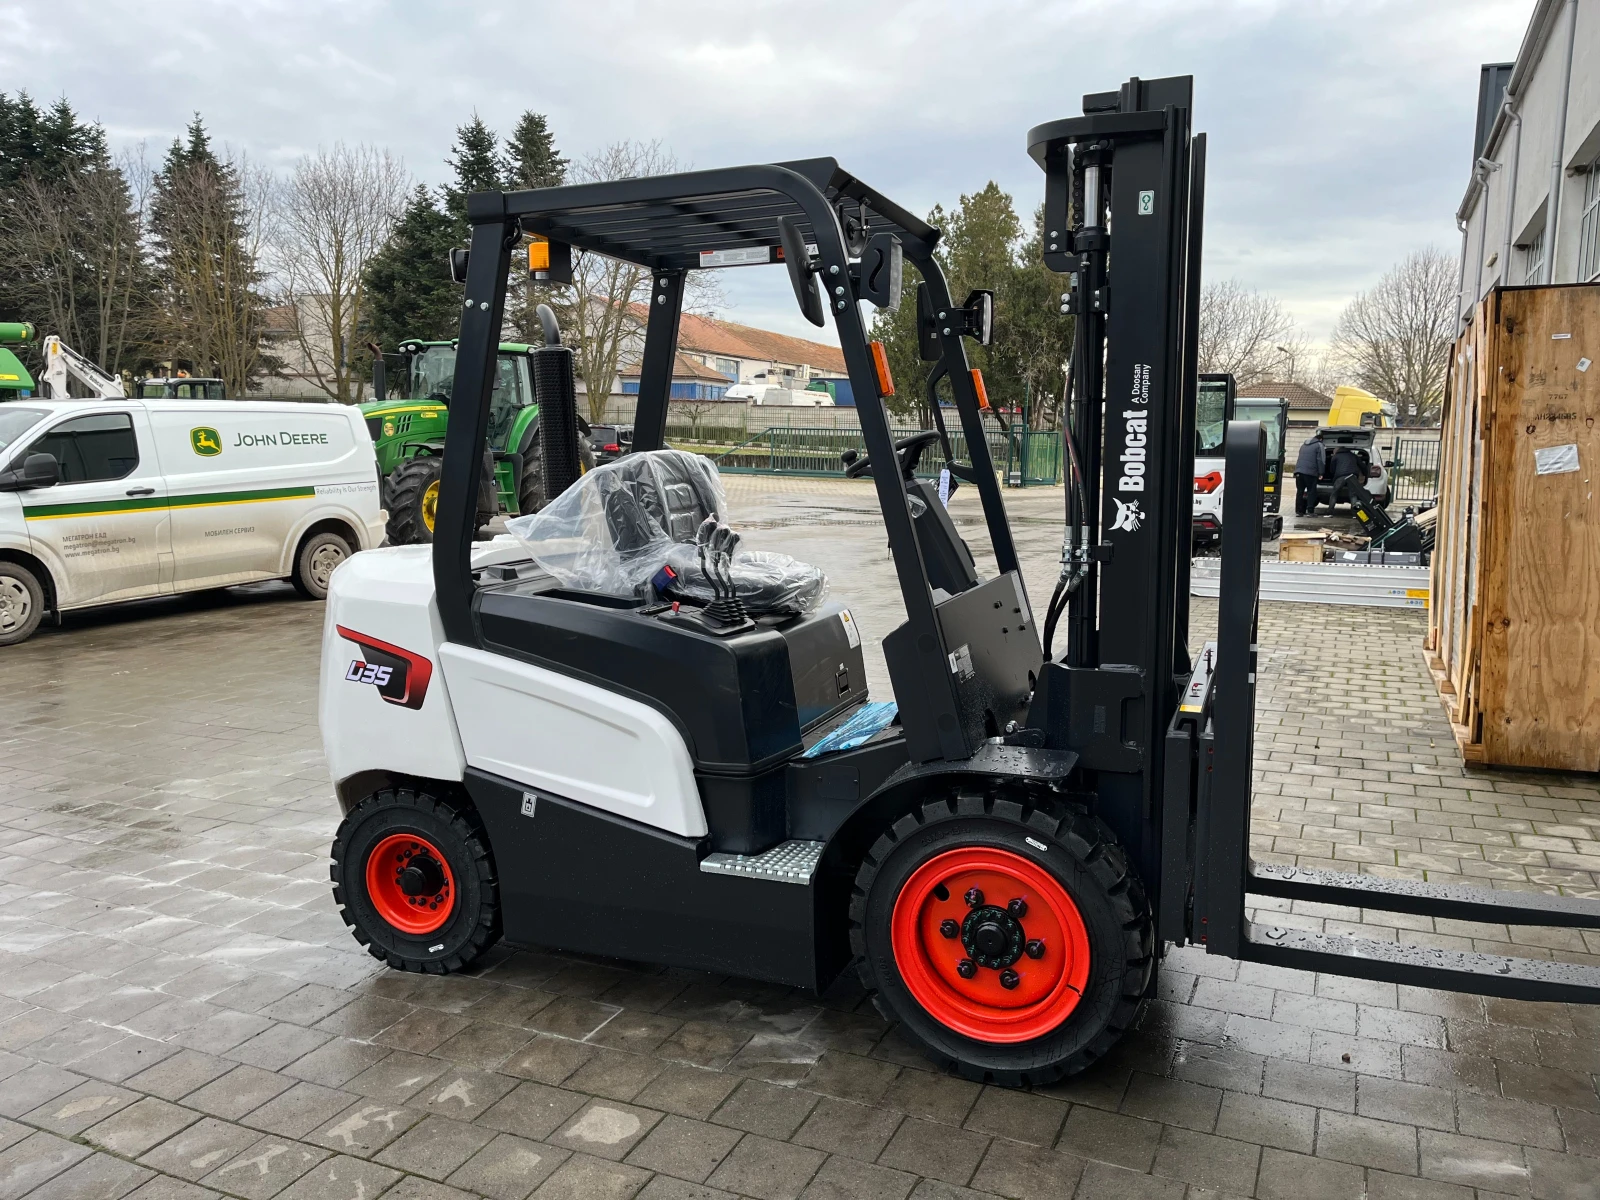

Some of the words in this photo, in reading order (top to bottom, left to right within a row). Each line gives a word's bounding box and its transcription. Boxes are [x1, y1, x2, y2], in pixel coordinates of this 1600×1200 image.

[1131, 363, 1141, 395] Doosan
[1140, 363, 1152, 404] Company
[1131, 396, 1140, 404] A
[233, 432, 277, 447] JOHN
[279, 431, 329, 446] DEERE
[1118, 409, 1148, 492] Bobcat
[347, 485, 357, 493] Our
[357, 484, 377, 492] Strength
[62, 534, 94, 542] МЕГАТРОН
[204, 529, 233, 537] МОБИЛЕН
[234, 526, 255, 535] СЕРВИЗ
[63, 537, 136, 550] megatron@megatron.bg
[65, 546, 120, 558] www.megatron.bg
[345, 660, 393, 687] D35
